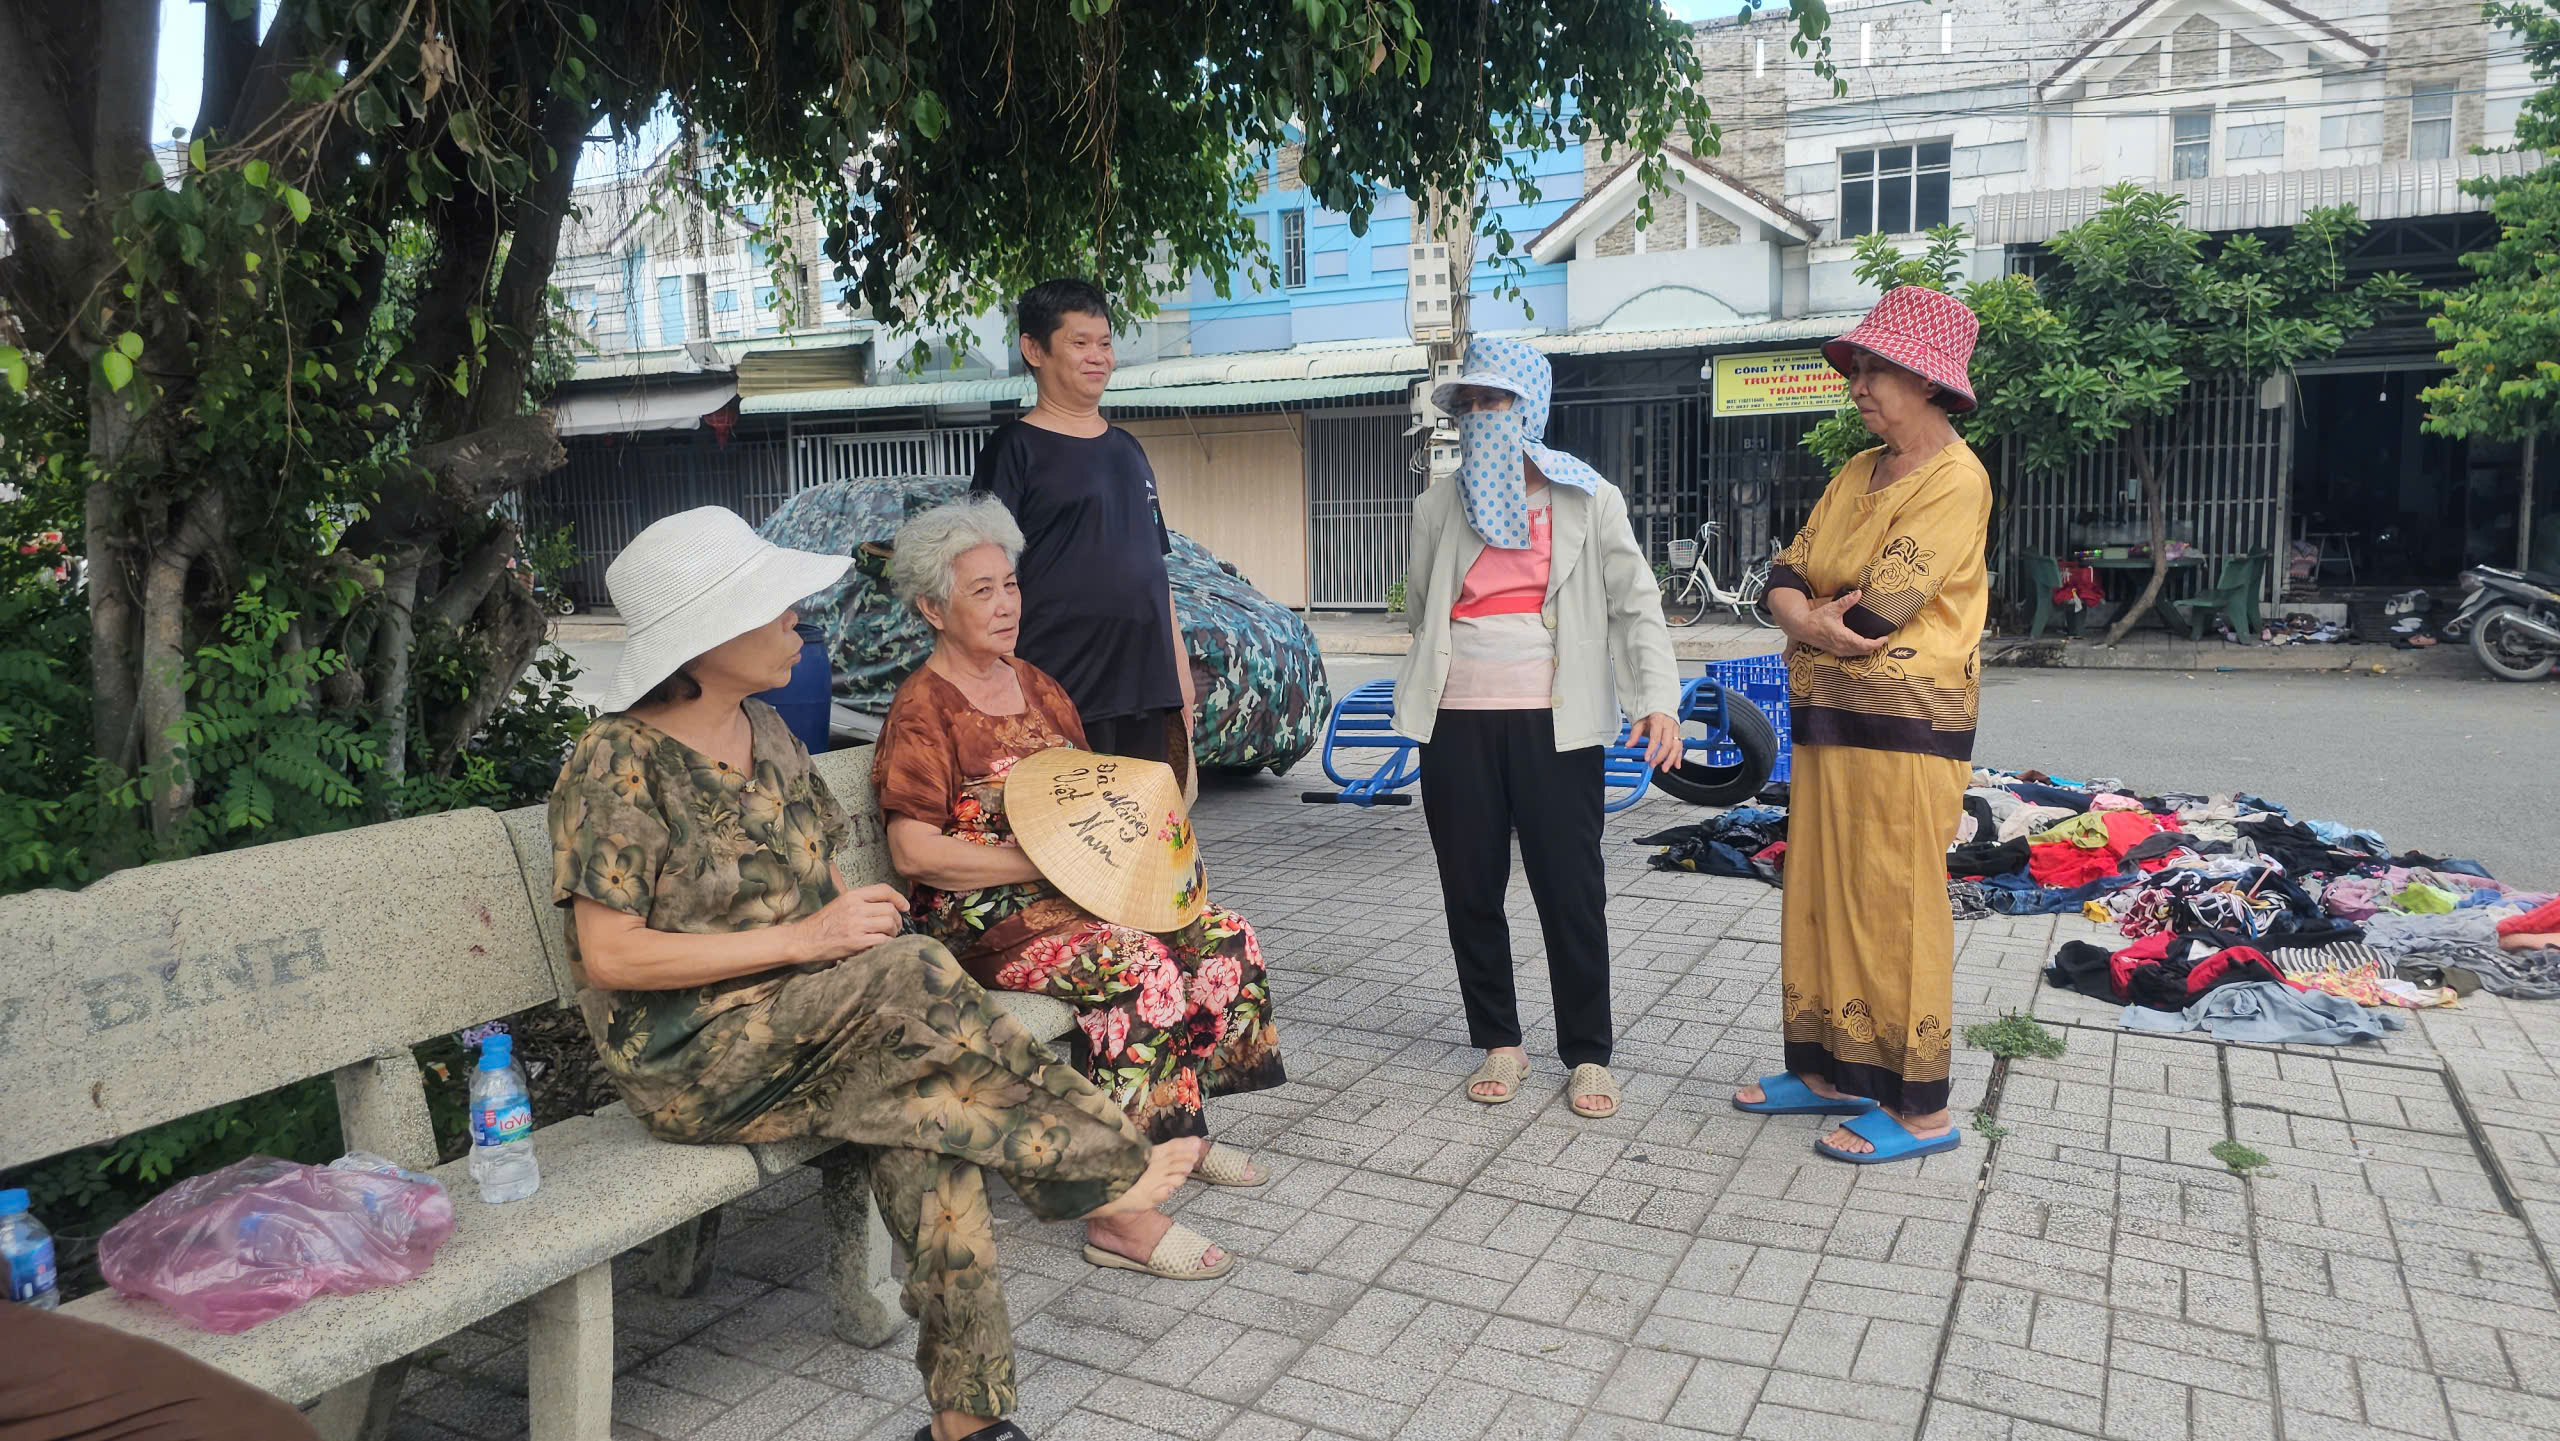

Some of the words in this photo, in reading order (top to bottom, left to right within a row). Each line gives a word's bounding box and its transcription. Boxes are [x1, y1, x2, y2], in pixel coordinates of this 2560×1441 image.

[1734, 363, 1768, 375] CÔNG
[1790, 363, 1822, 371] TNHH
[1068, 811, 1121, 869] Nam
